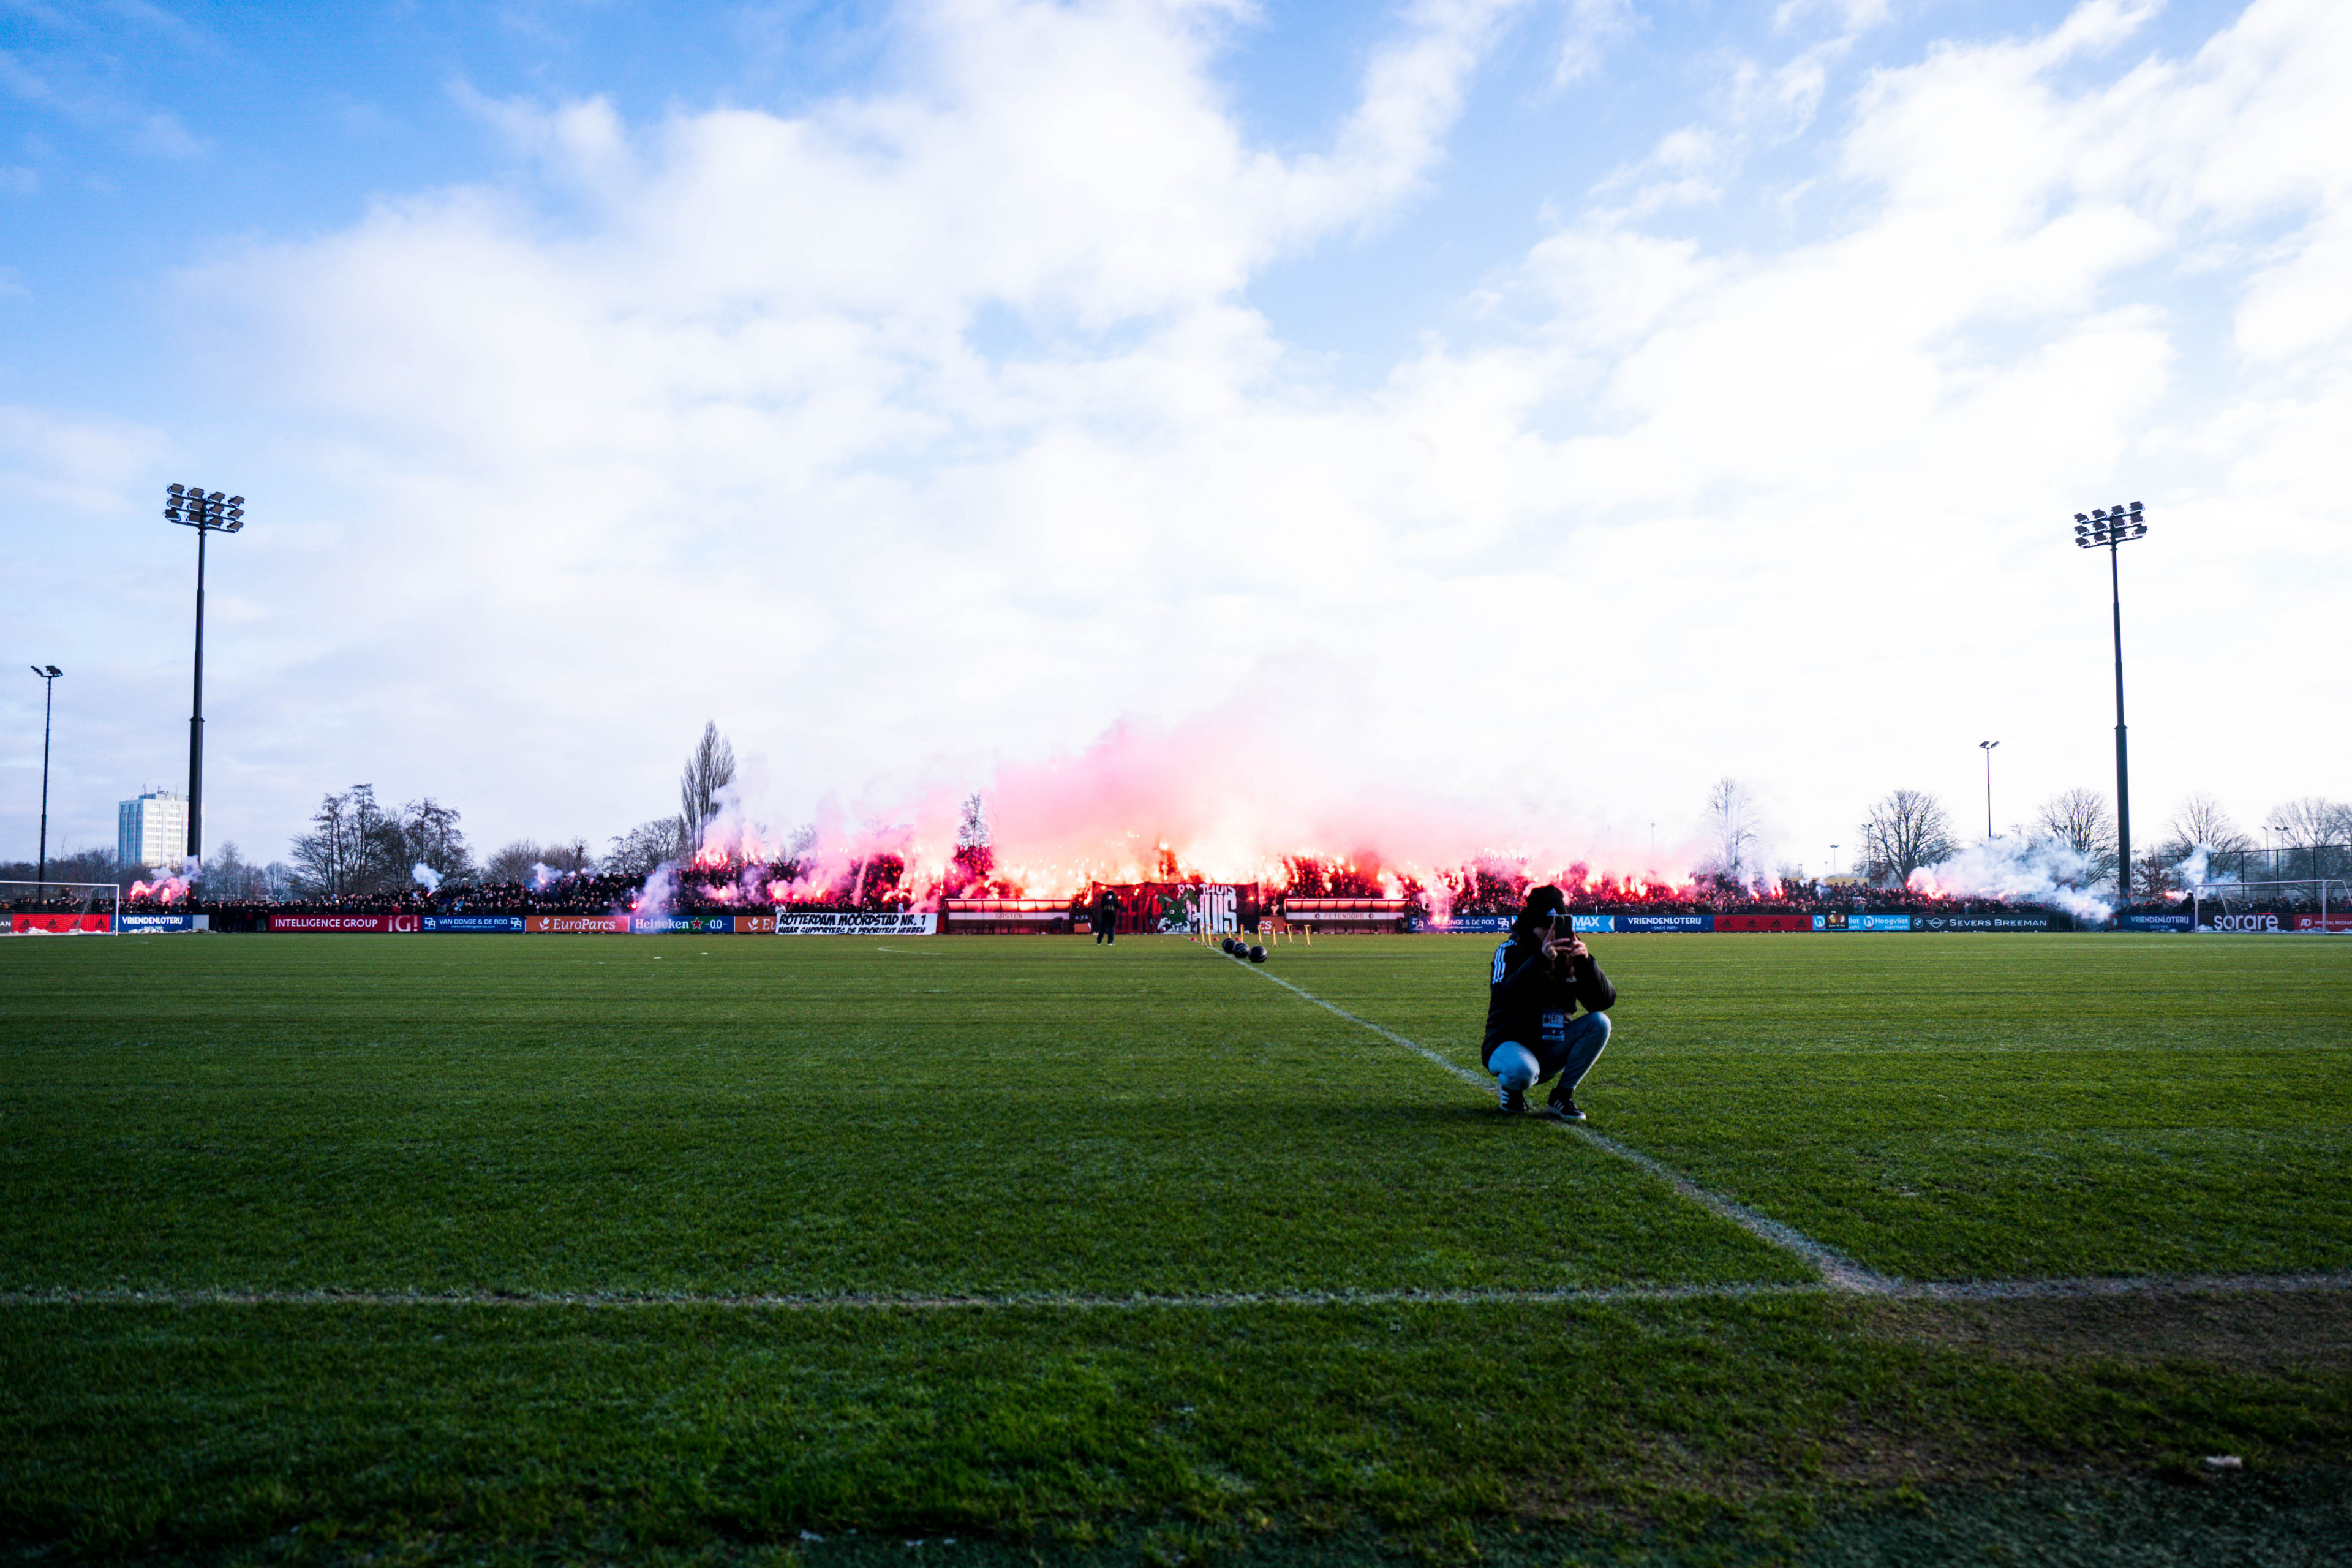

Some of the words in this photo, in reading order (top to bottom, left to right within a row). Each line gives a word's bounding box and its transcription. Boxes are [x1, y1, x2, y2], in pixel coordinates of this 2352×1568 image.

[275, 919, 341, 928] INTELLIGENCE
[342, 919, 378, 927] GROUP
[553, 918, 616, 930] EuroParcs
[635, 919, 689, 929] Heineken
[779, 914, 836, 926] ROTTERDAM
[837, 914, 899, 926] MOORDSTAD
[900, 914, 917, 926] NR.
[921, 914, 926, 925] 1
[2214, 915, 2278, 930] sorare
